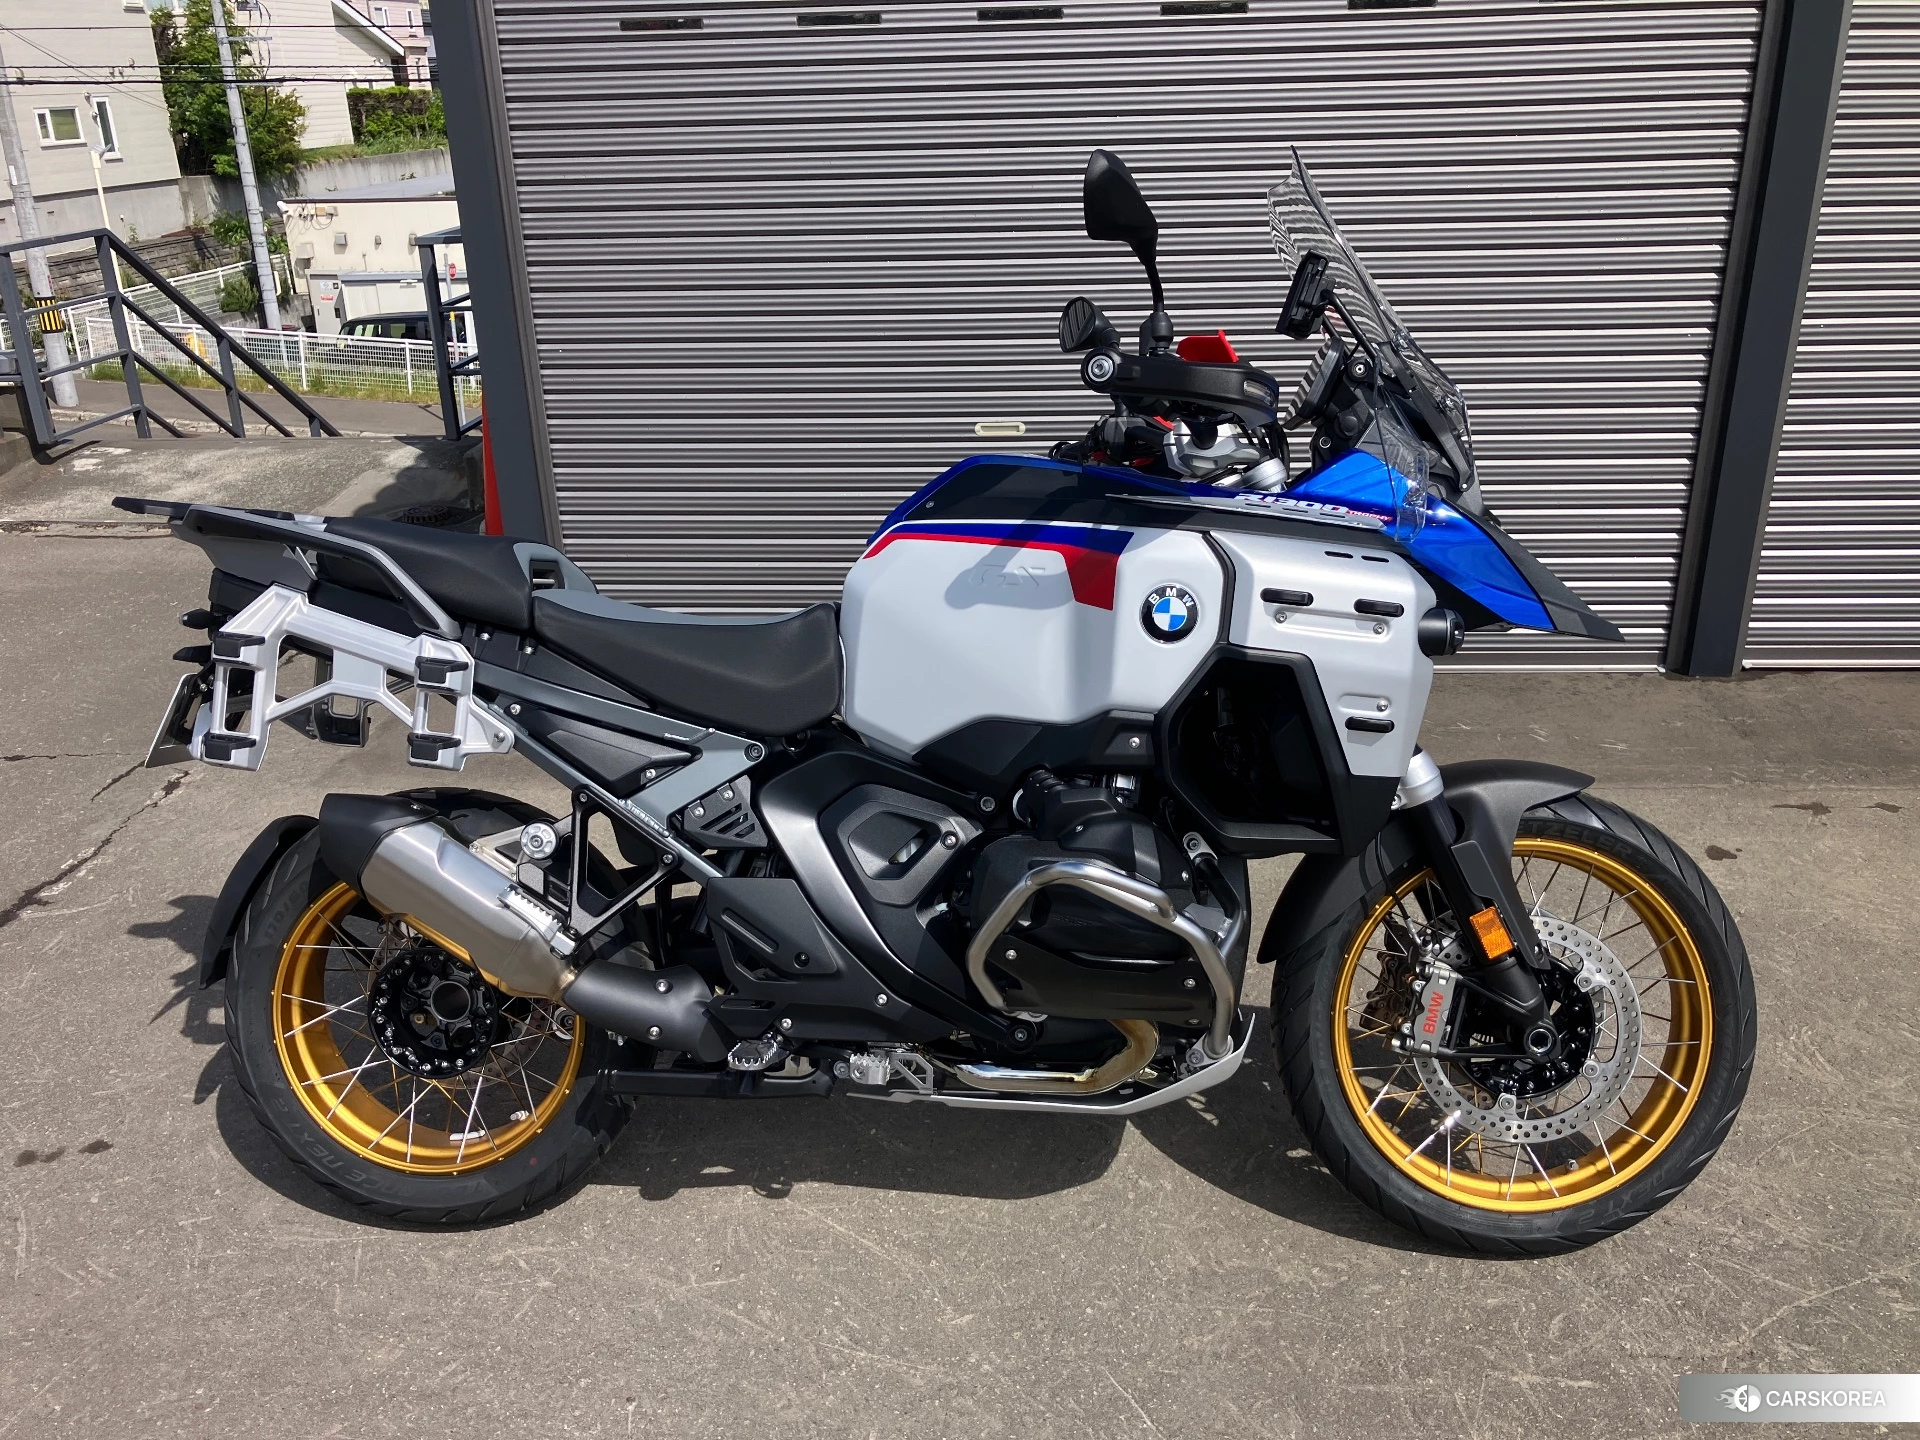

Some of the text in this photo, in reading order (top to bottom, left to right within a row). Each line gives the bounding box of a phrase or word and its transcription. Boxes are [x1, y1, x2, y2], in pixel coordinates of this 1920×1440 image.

[1147, 587, 1195, 607] BMW
[1516, 820, 1634, 859] ETZELER
[1422, 990, 1445, 1034] BMW
